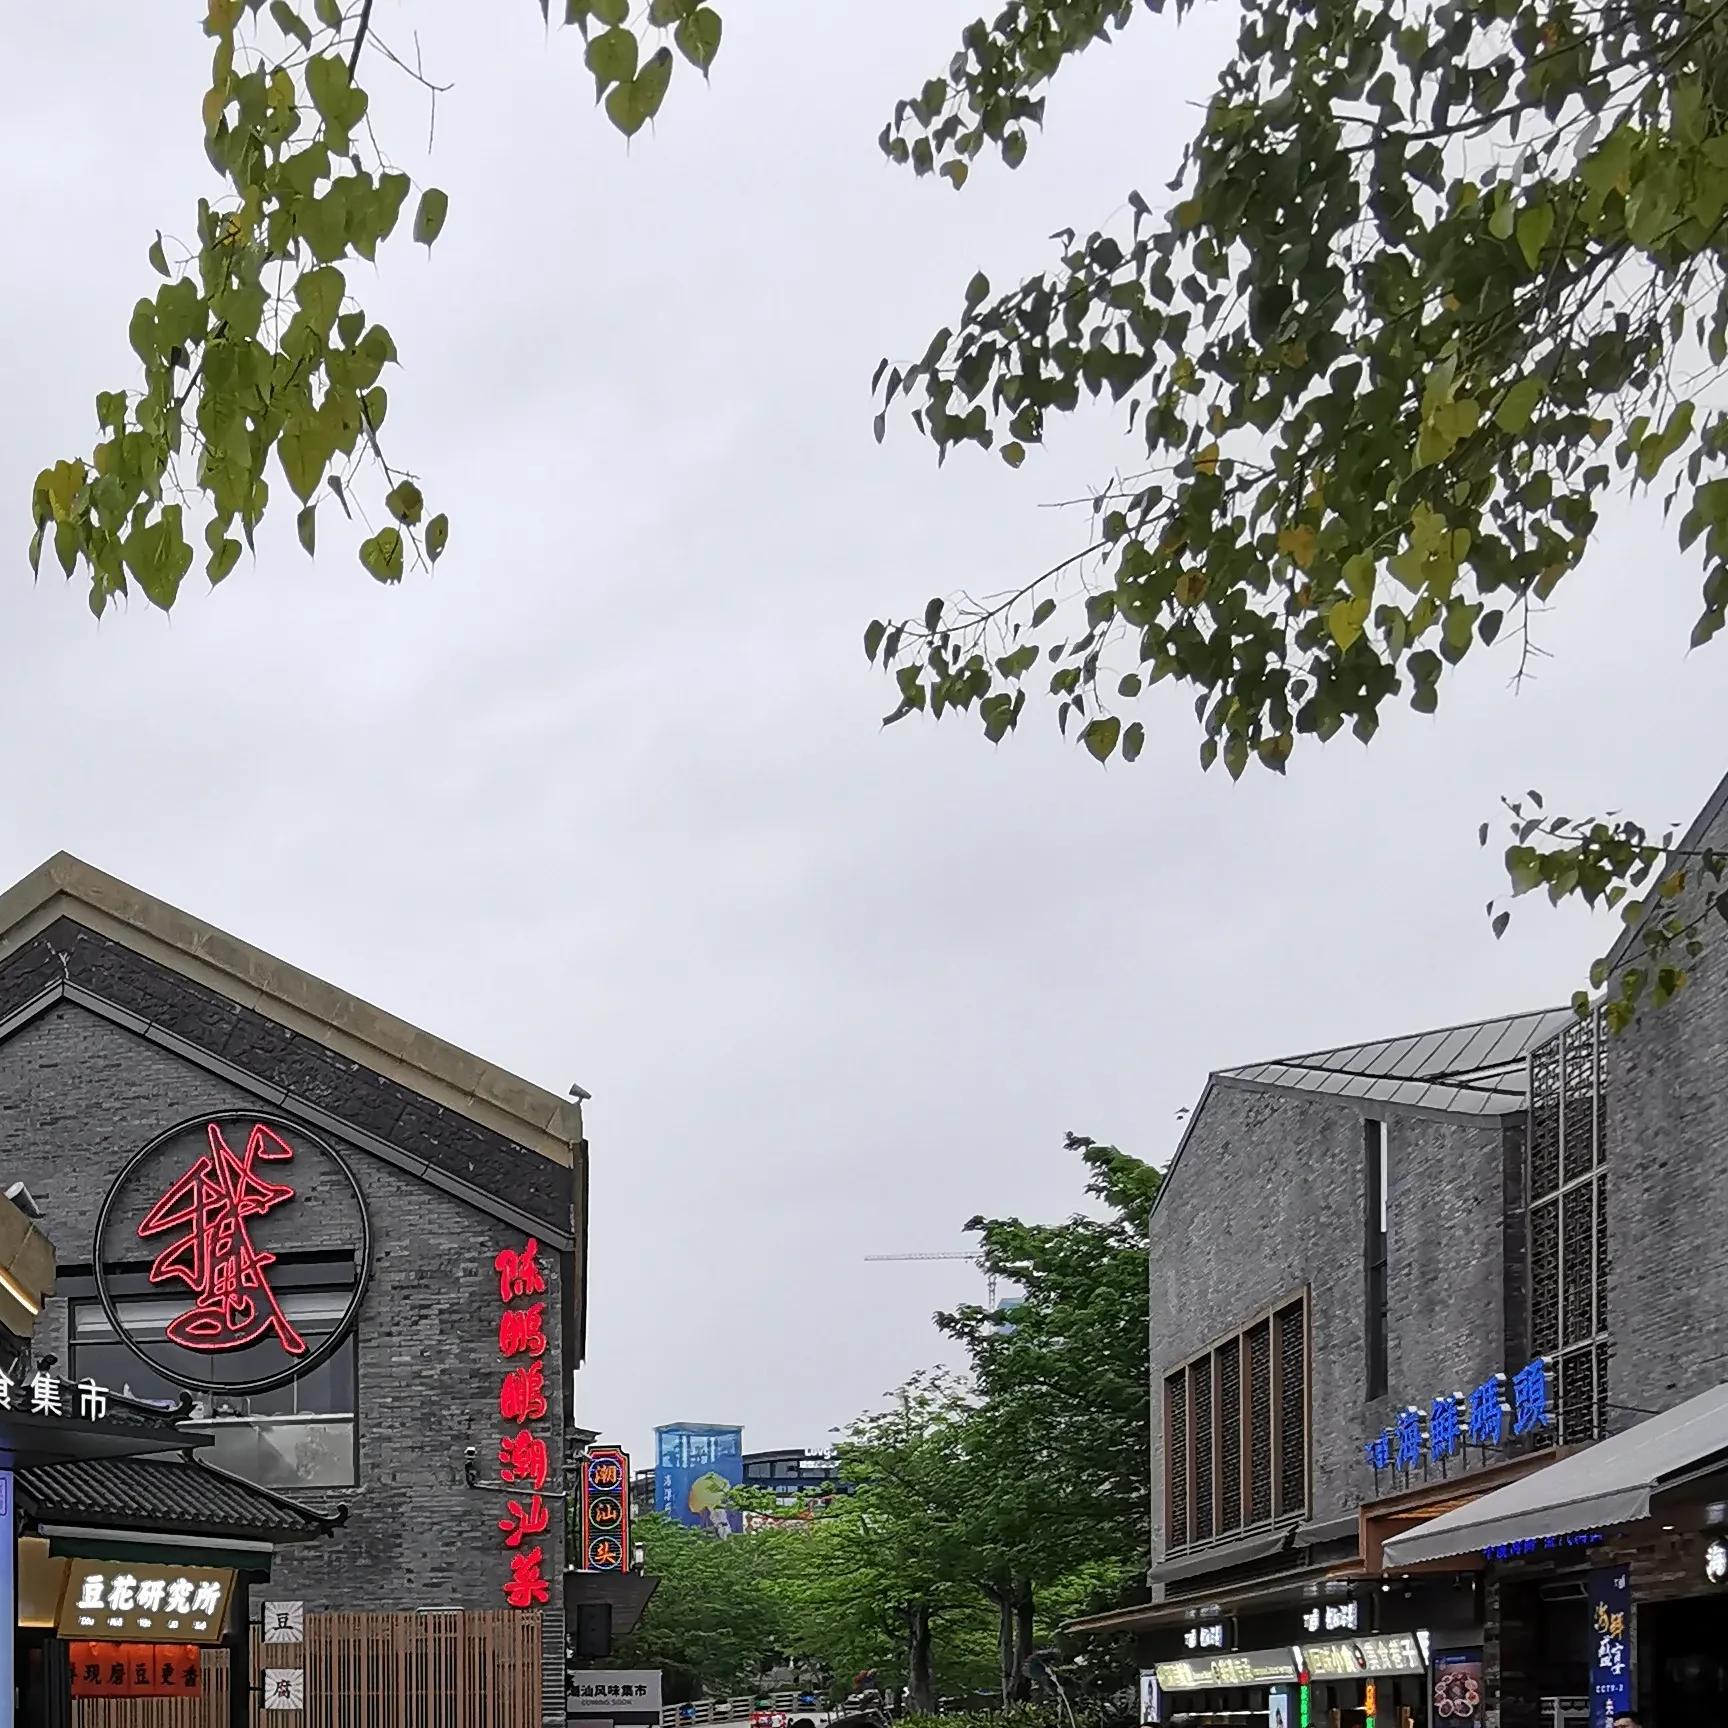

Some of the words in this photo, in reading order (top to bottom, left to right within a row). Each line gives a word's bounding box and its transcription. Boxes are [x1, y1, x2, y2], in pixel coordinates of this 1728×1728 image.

[76, 1573, 221, 1616] 豆花研究所
